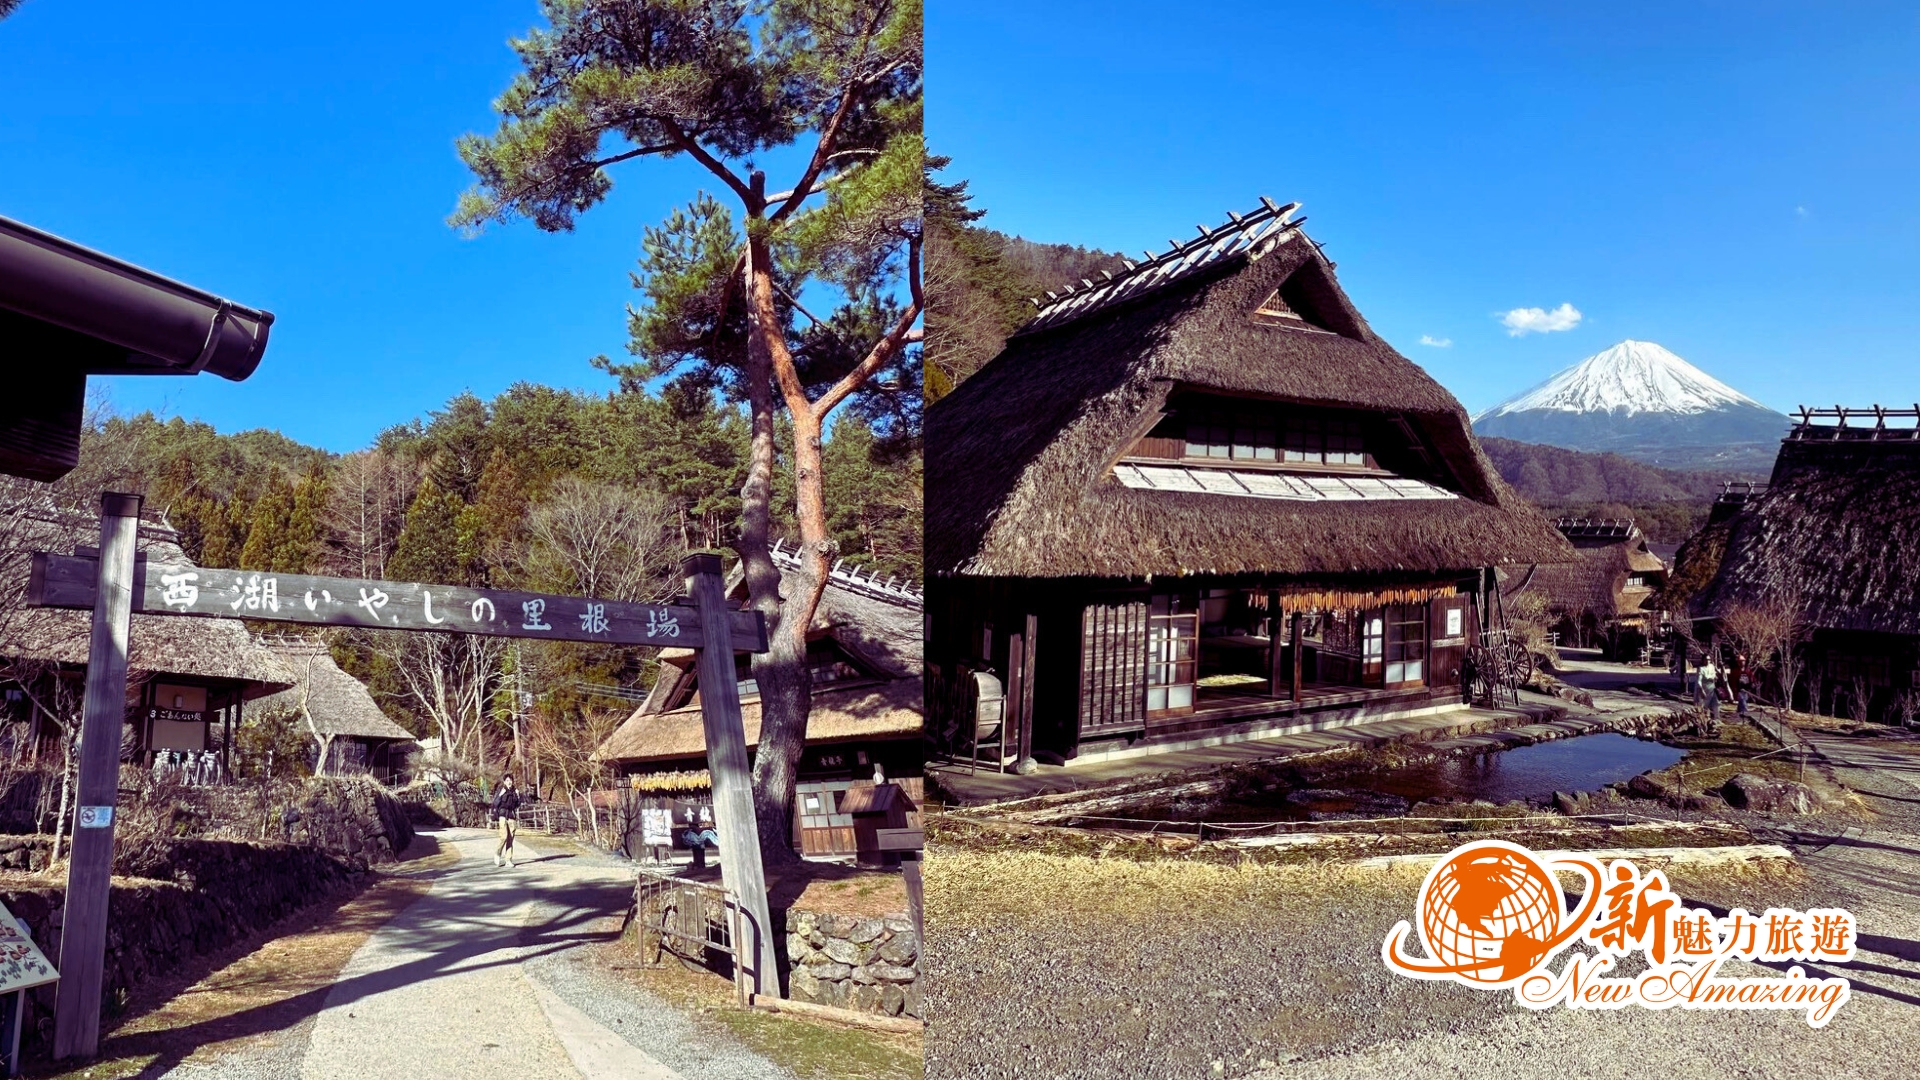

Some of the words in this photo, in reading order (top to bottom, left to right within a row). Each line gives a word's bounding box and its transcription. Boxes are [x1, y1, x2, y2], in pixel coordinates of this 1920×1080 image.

[162, 573, 681, 637] 西湖いやしの里根場
